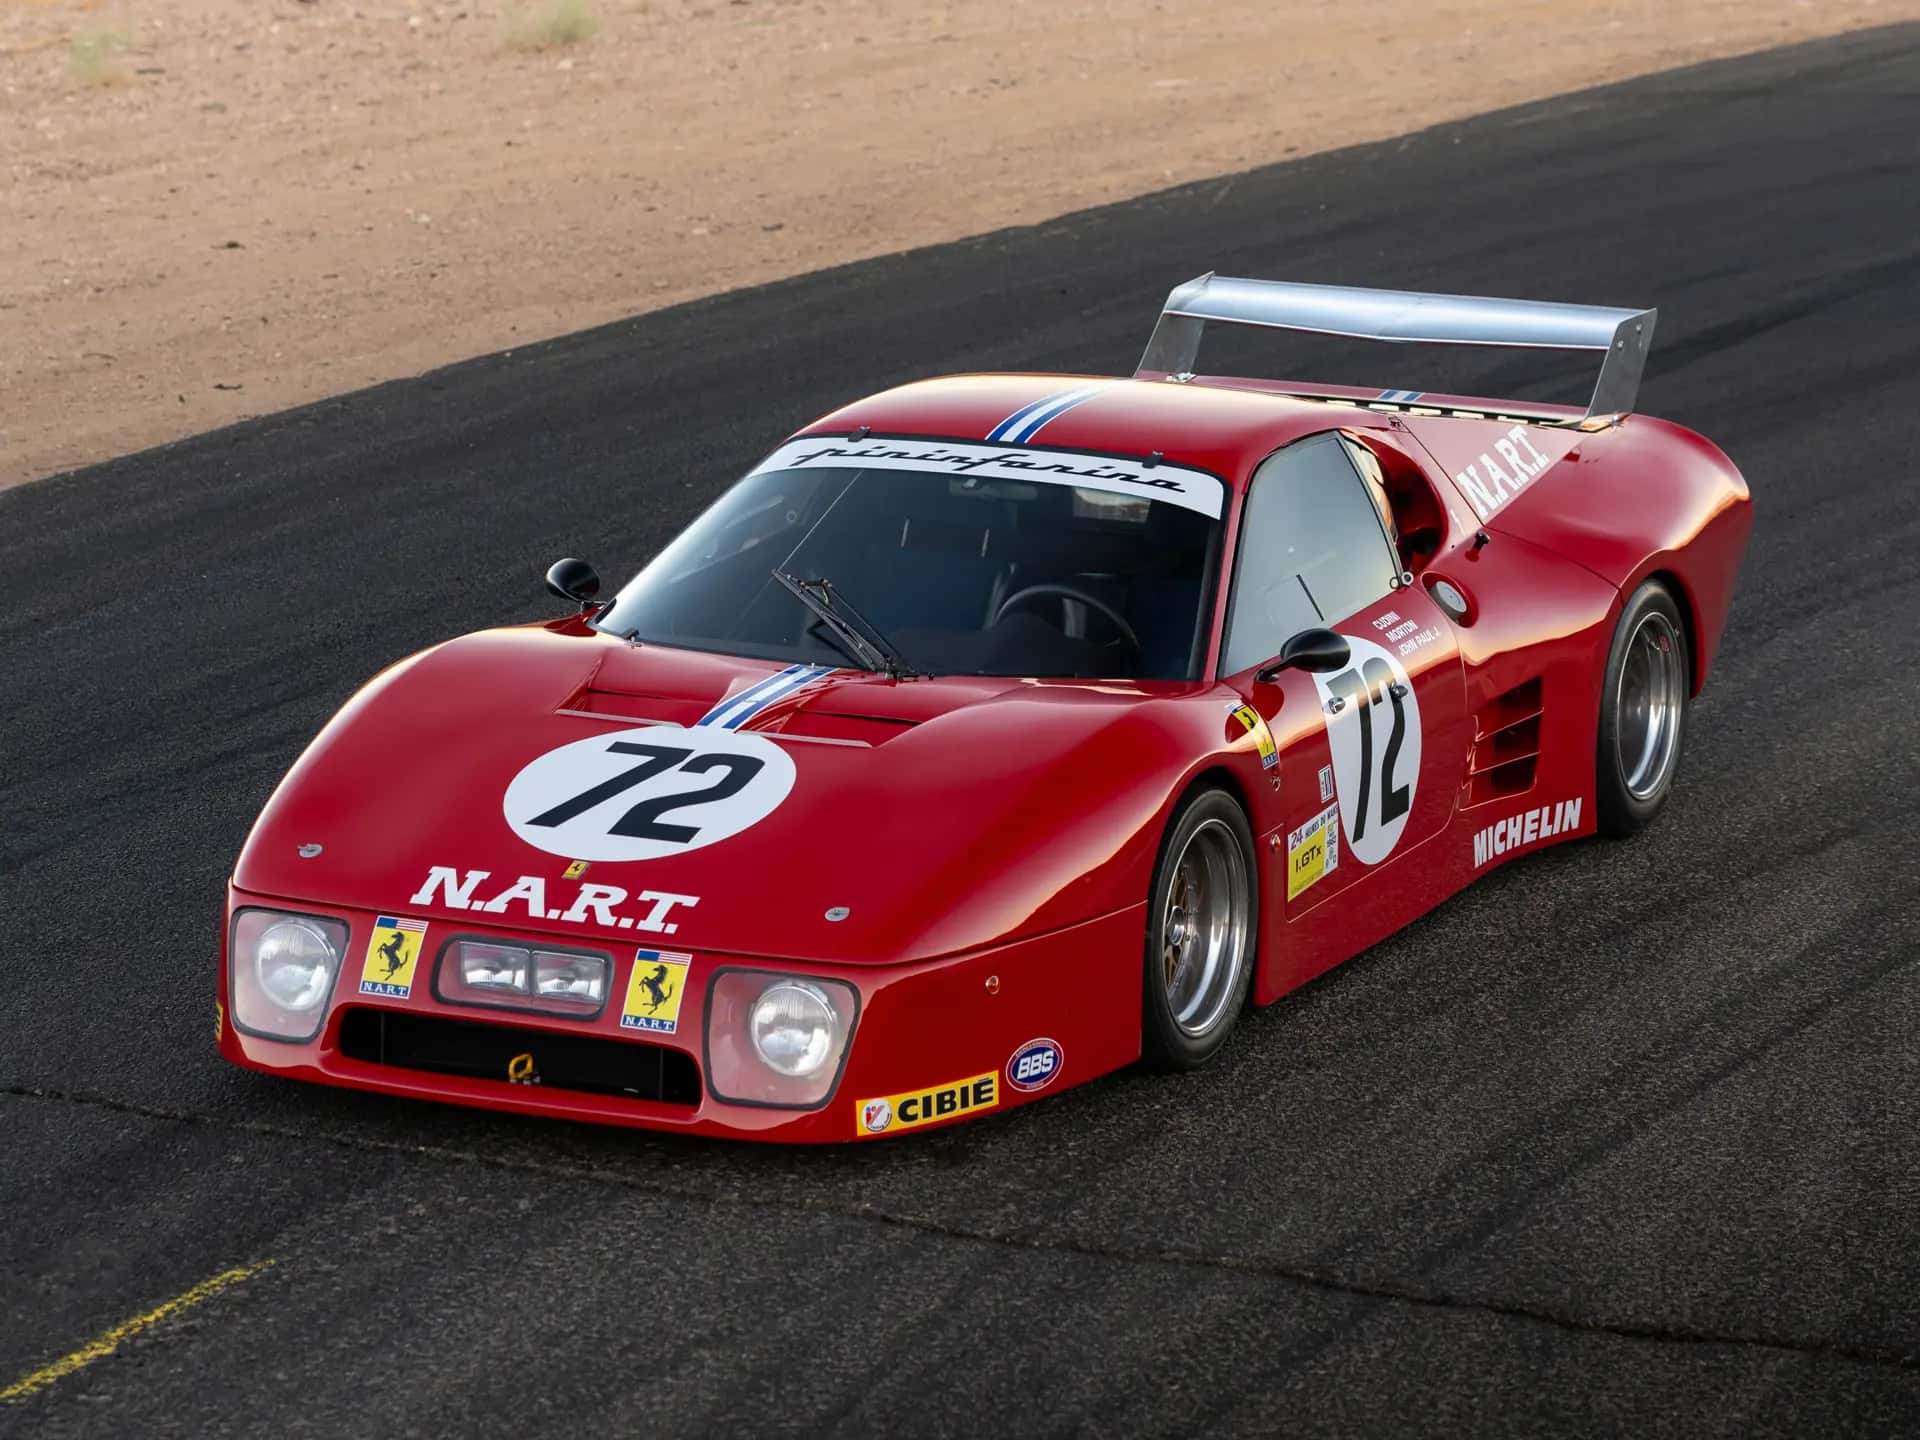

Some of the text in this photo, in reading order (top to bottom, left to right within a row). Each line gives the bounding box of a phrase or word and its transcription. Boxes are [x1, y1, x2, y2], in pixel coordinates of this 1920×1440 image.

[788, 445, 1186, 494] pininfarina
[1325, 656, 1410, 845] 72
[523, 740, 766, 844] 72
[1472, 796, 1583, 869] MICHELIN
[408, 865, 702, 935] N.A.R.T.
[1016, 1050, 1055, 1080] BBS
